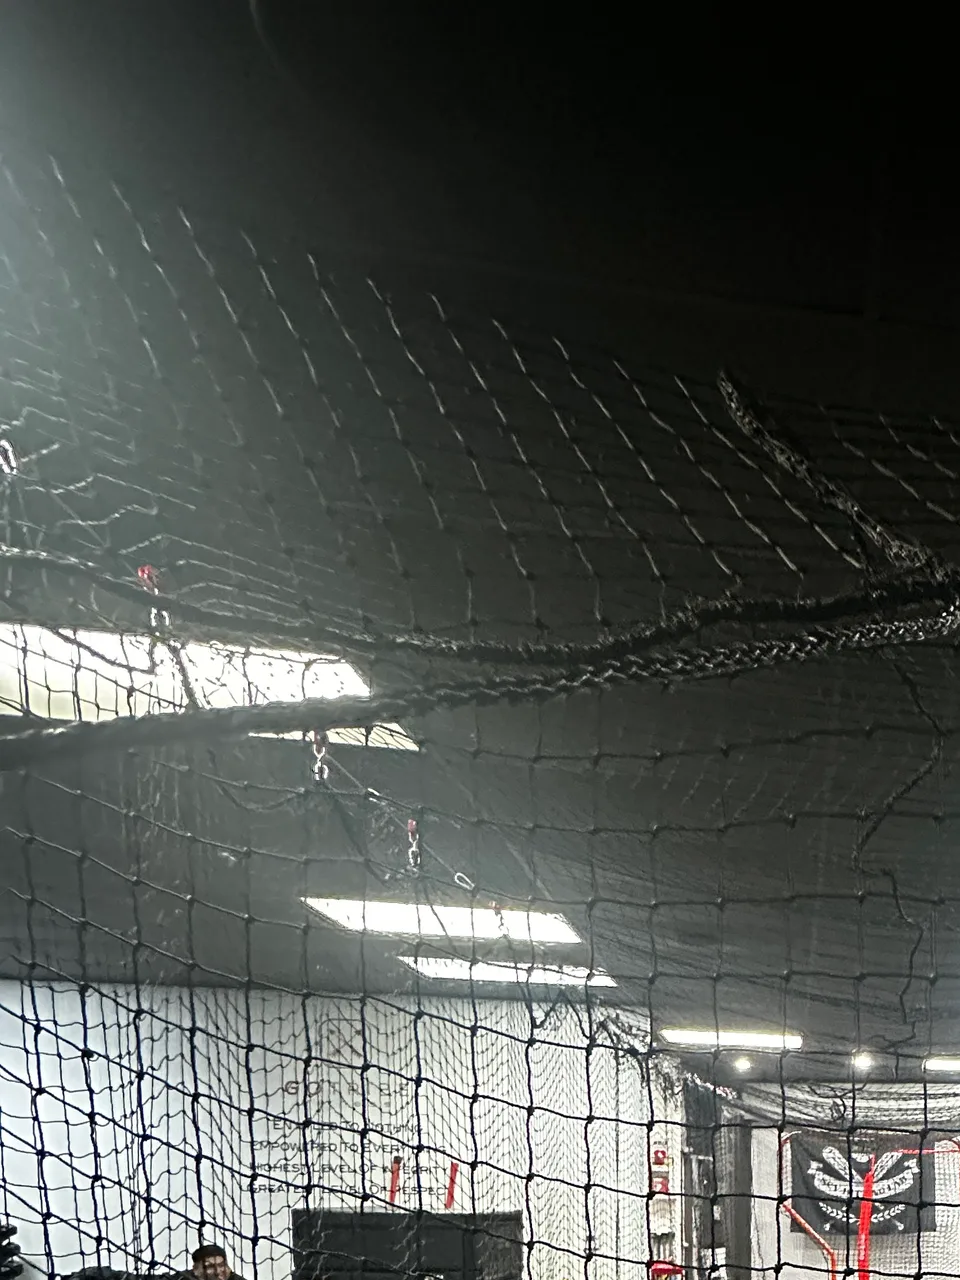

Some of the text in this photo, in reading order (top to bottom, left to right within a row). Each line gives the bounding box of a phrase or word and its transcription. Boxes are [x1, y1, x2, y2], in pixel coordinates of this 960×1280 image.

[273, 1117, 337, 1130] ENLED
[341, 1142, 359, 1152] TO
[312, 1164, 356, 1174] LEVEL
[359, 1164, 377, 1174] OF
[382, 1165, 449, 1176] INEGRITY
[392, 1186, 452, 1196] ESPEC
